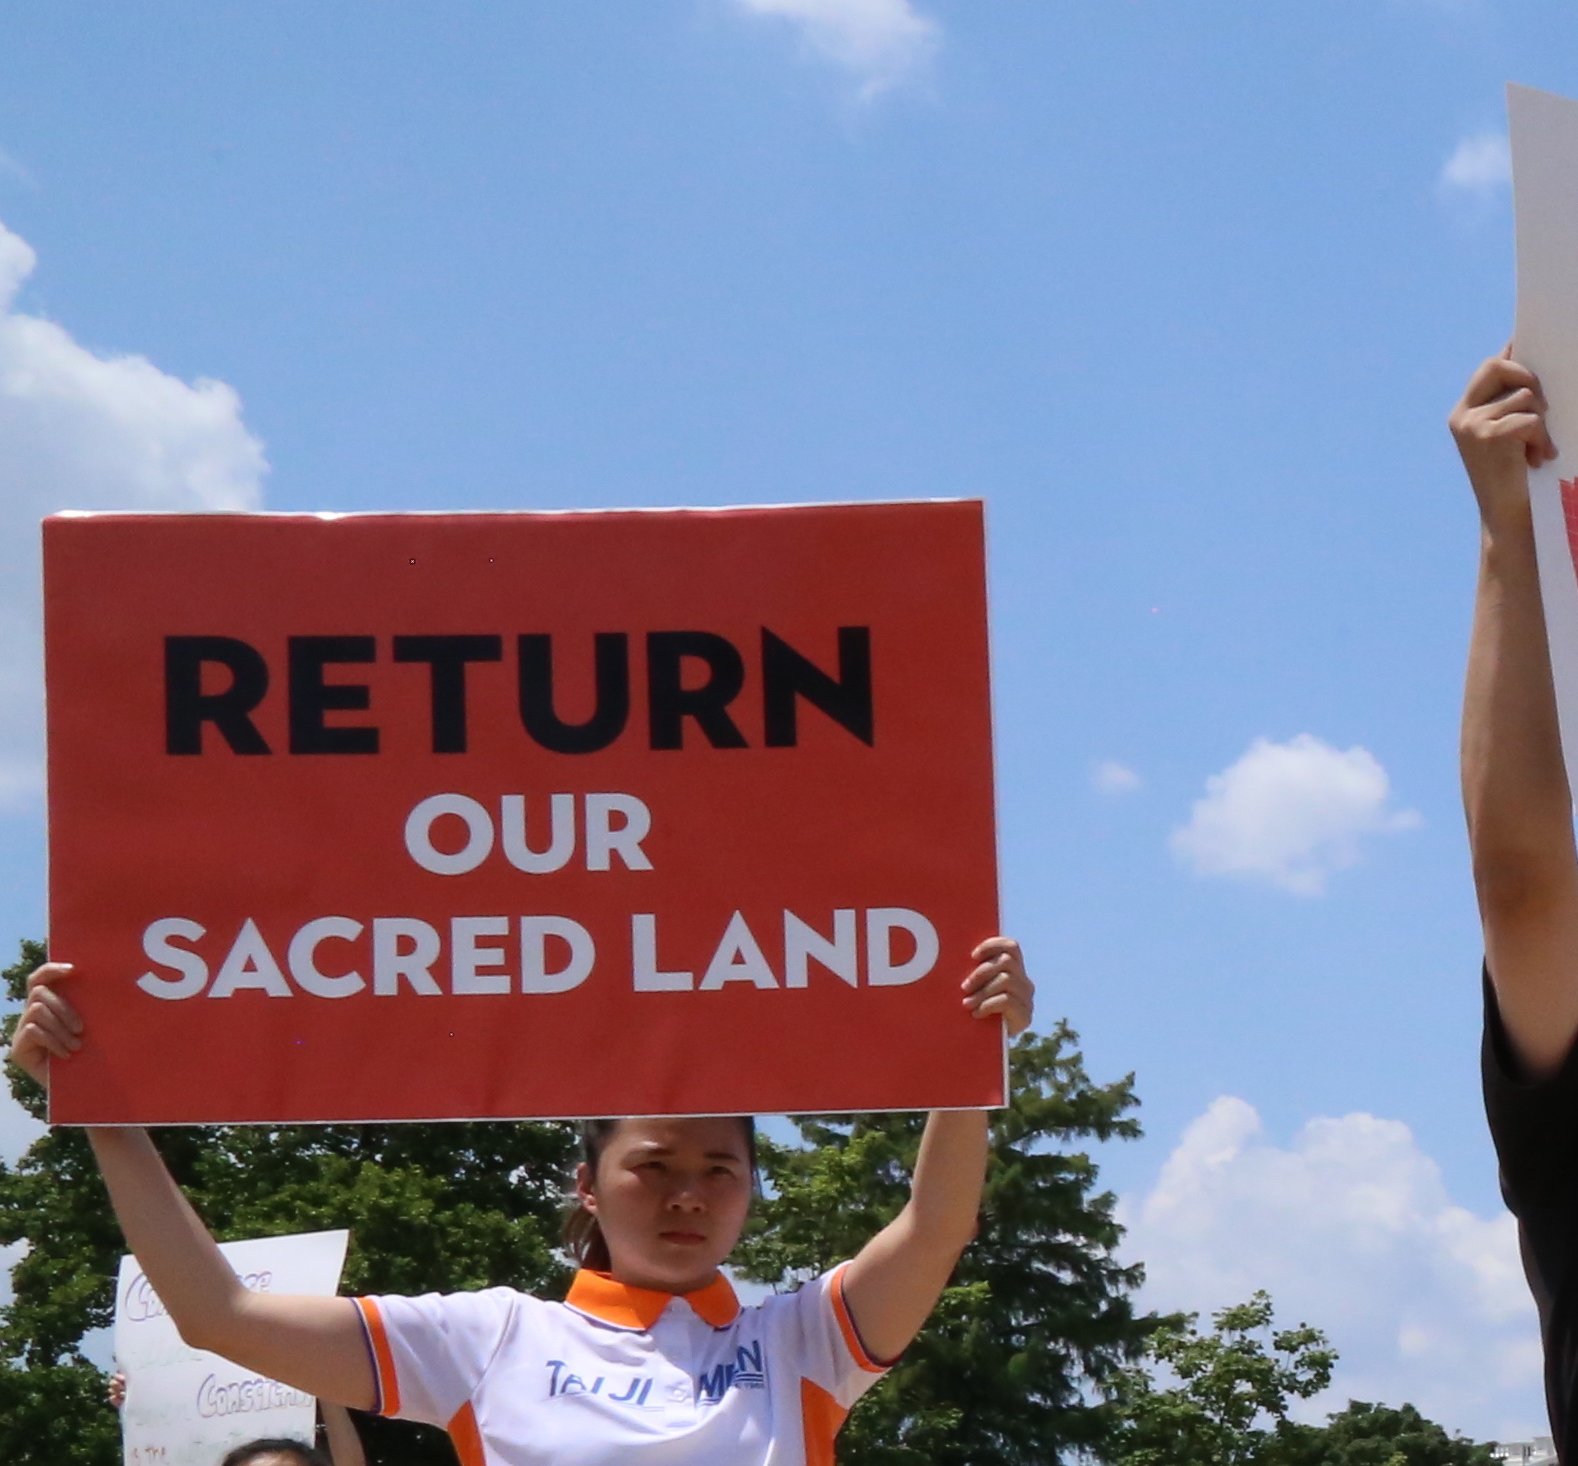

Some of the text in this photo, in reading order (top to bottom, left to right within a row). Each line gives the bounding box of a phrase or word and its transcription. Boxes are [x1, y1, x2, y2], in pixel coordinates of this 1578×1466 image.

[163, 625, 875, 756] RETURN
[404, 792, 654, 876] OUR
[136, 907, 940, 1000] SACRED LAND
[545, 1359, 605, 1397] TAI
[608, 1377, 653, 1406] JI
